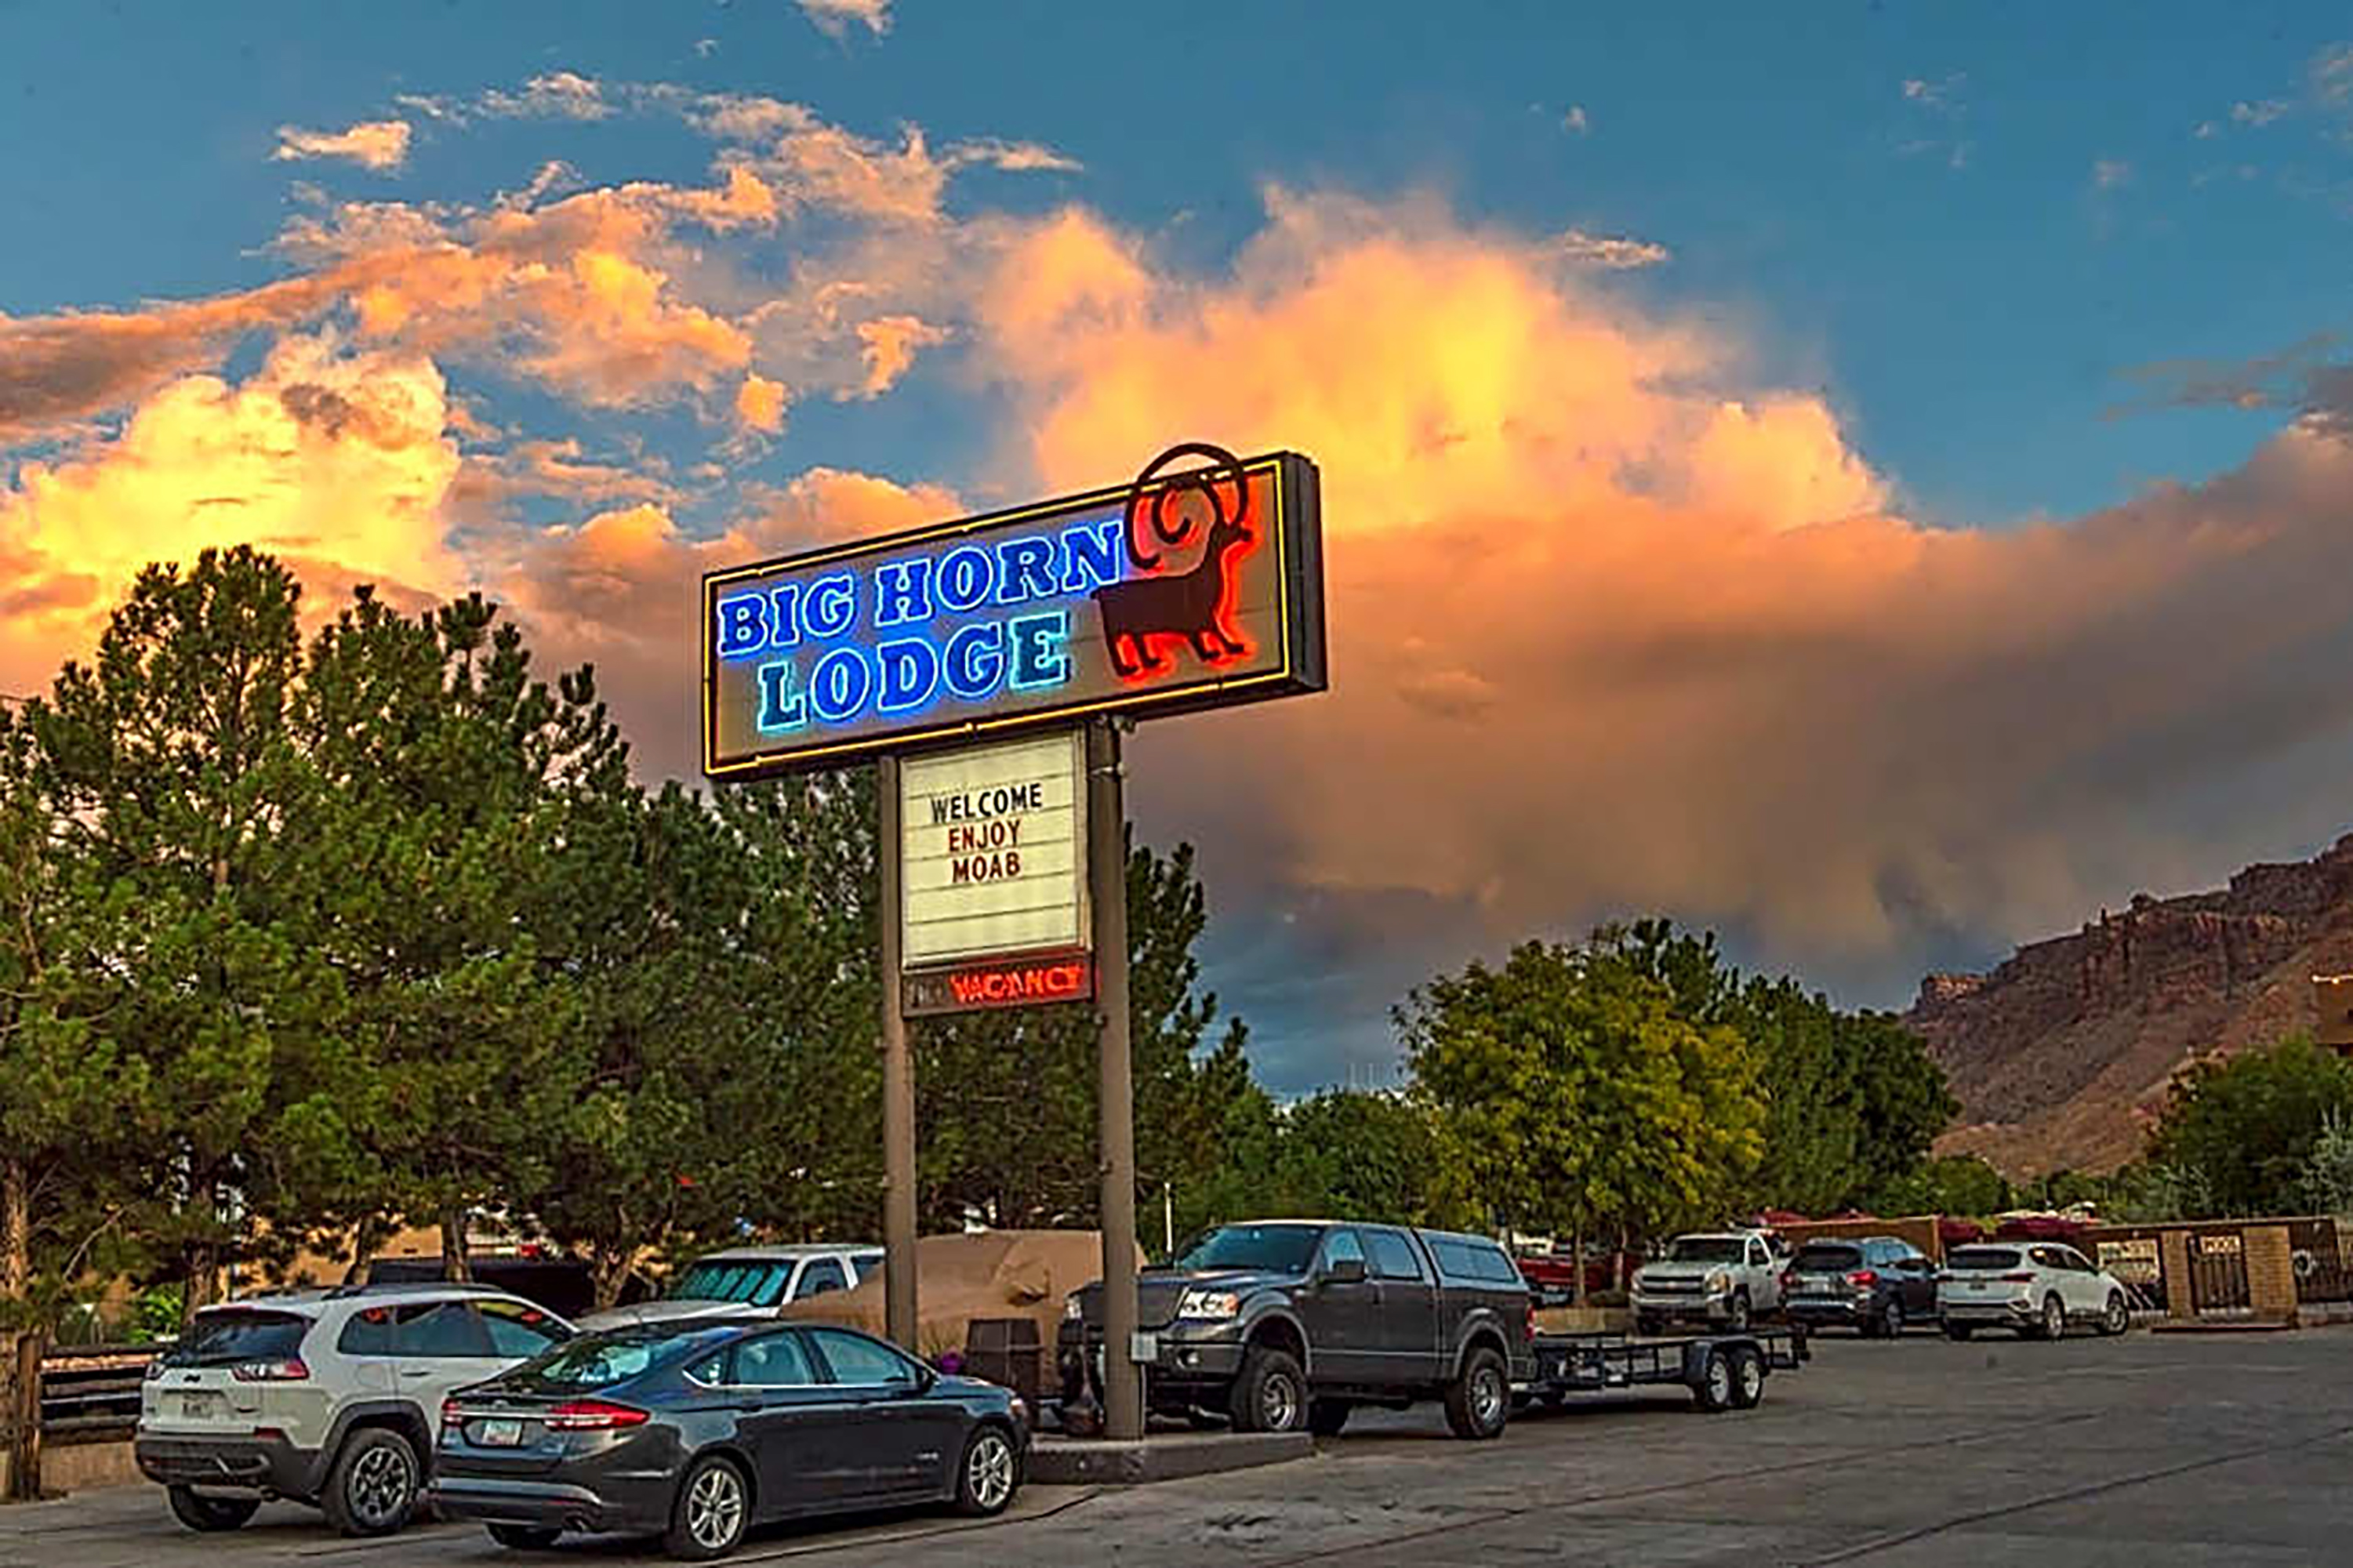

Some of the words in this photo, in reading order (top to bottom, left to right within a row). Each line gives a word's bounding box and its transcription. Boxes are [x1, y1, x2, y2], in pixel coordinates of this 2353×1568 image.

[717, 575, 855, 655] BIG
[875, 521, 1124, 626] HORN
[757, 611, 1070, 731] LODGE
[931, 783, 1042, 823] WELCOME
[949, 820, 1021, 851] ENJOY
[952, 852, 1021, 883] MOAB
[950, 964, 1084, 1002] VACANCY
